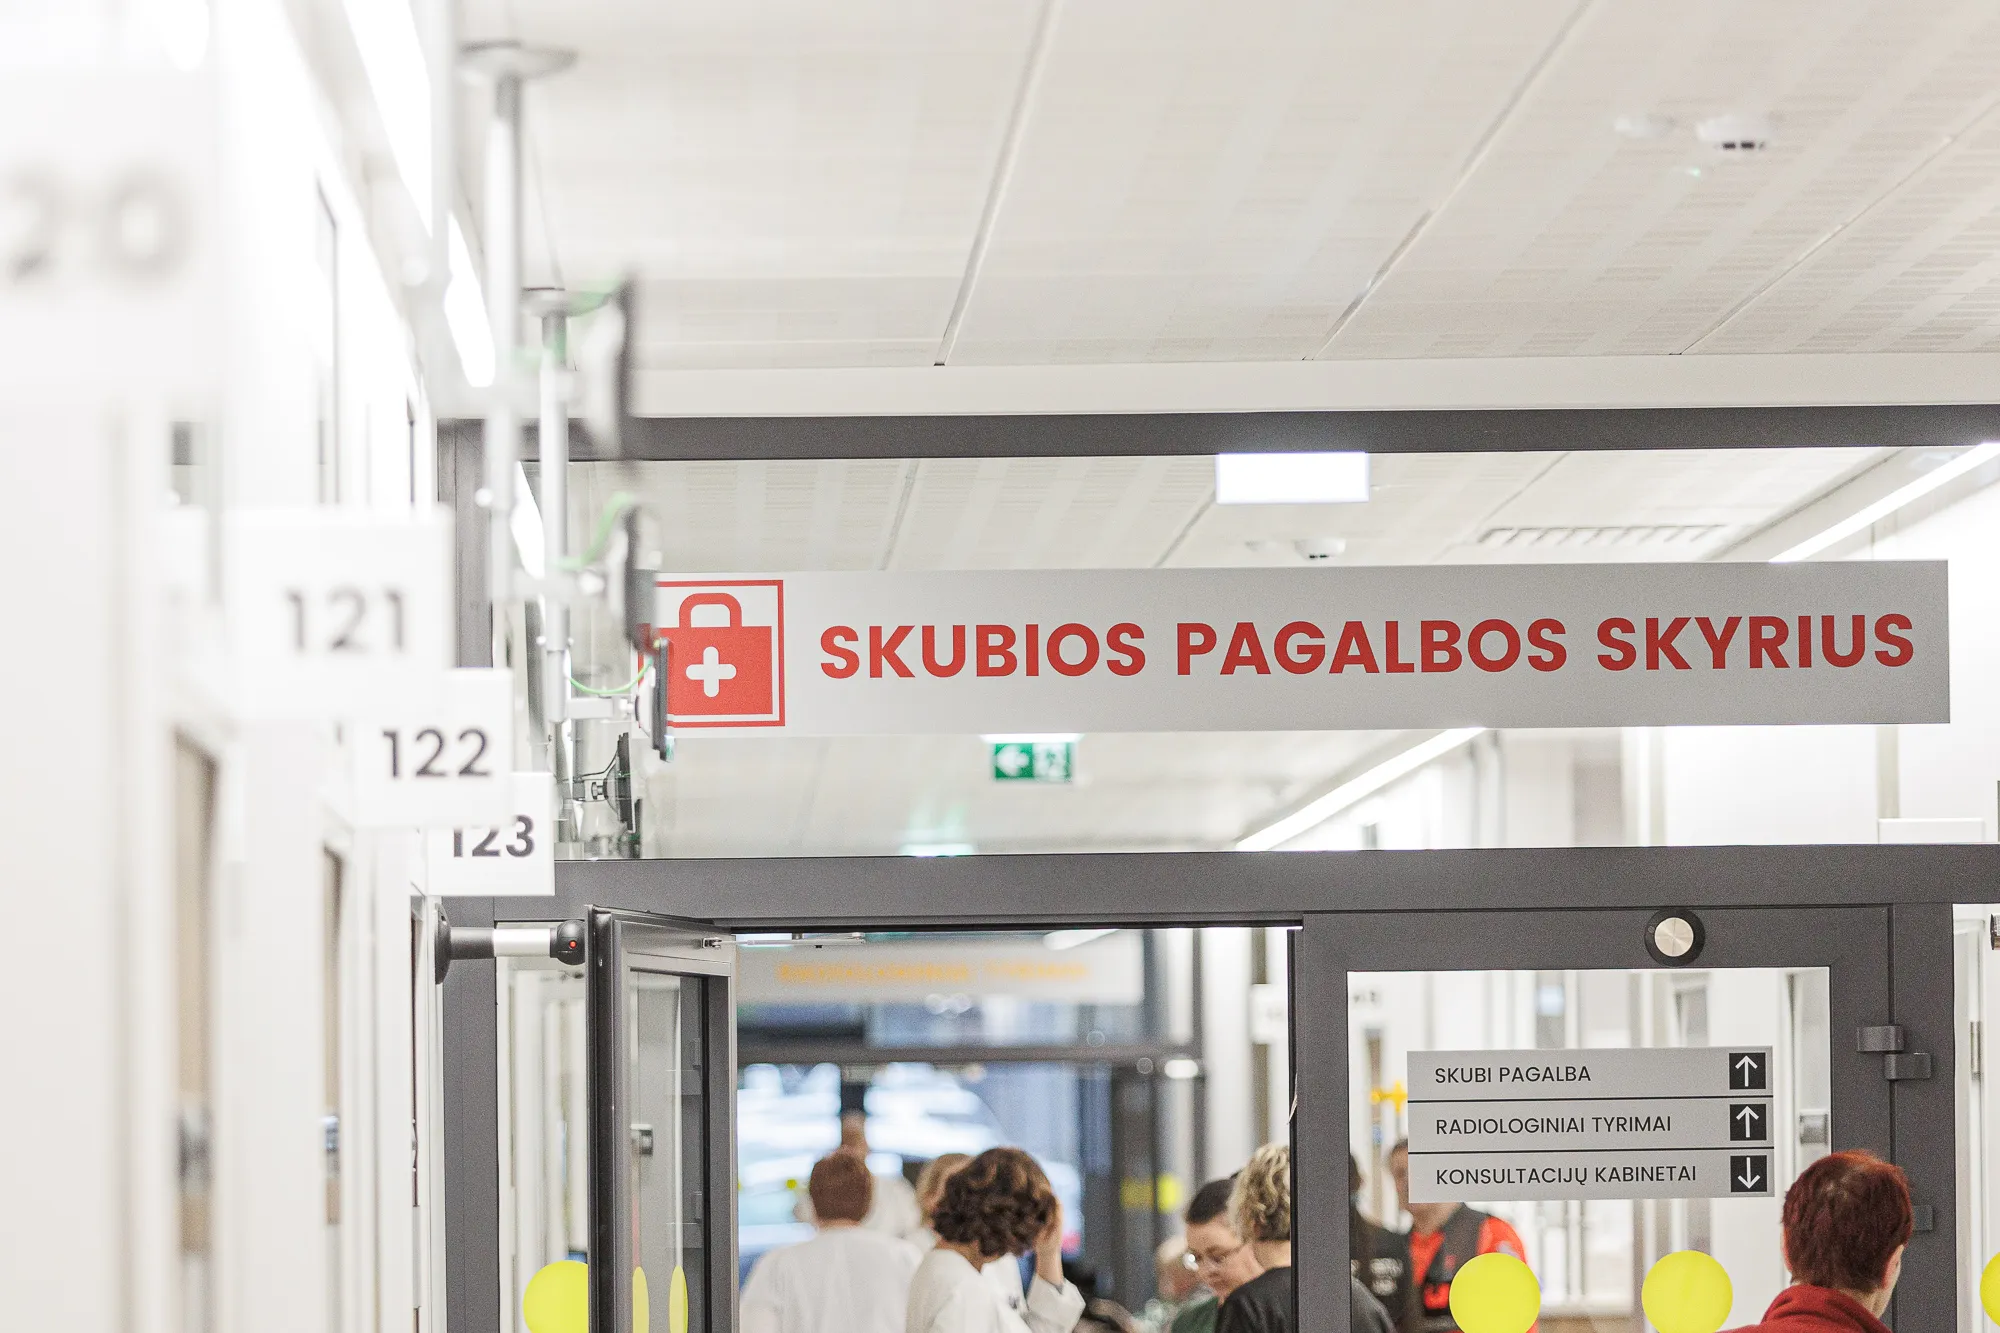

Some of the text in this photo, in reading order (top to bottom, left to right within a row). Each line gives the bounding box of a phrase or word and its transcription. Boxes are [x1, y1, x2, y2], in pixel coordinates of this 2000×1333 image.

[287, 587, 404, 652] 121
[820, 613, 1914, 680] SKUBIOS PAGALBOS SKYRIUS
[382, 728, 488, 778] 122
[453, 814, 534, 858] 123
[1435, 1065, 1592, 1084] SKUBI PAGALBA
[1436, 1115, 1671, 1135] RADIOLOGINIAI TYRIMAI
[1436, 1165, 1696, 1186] KONSULTACIJŲ KABINETAI
